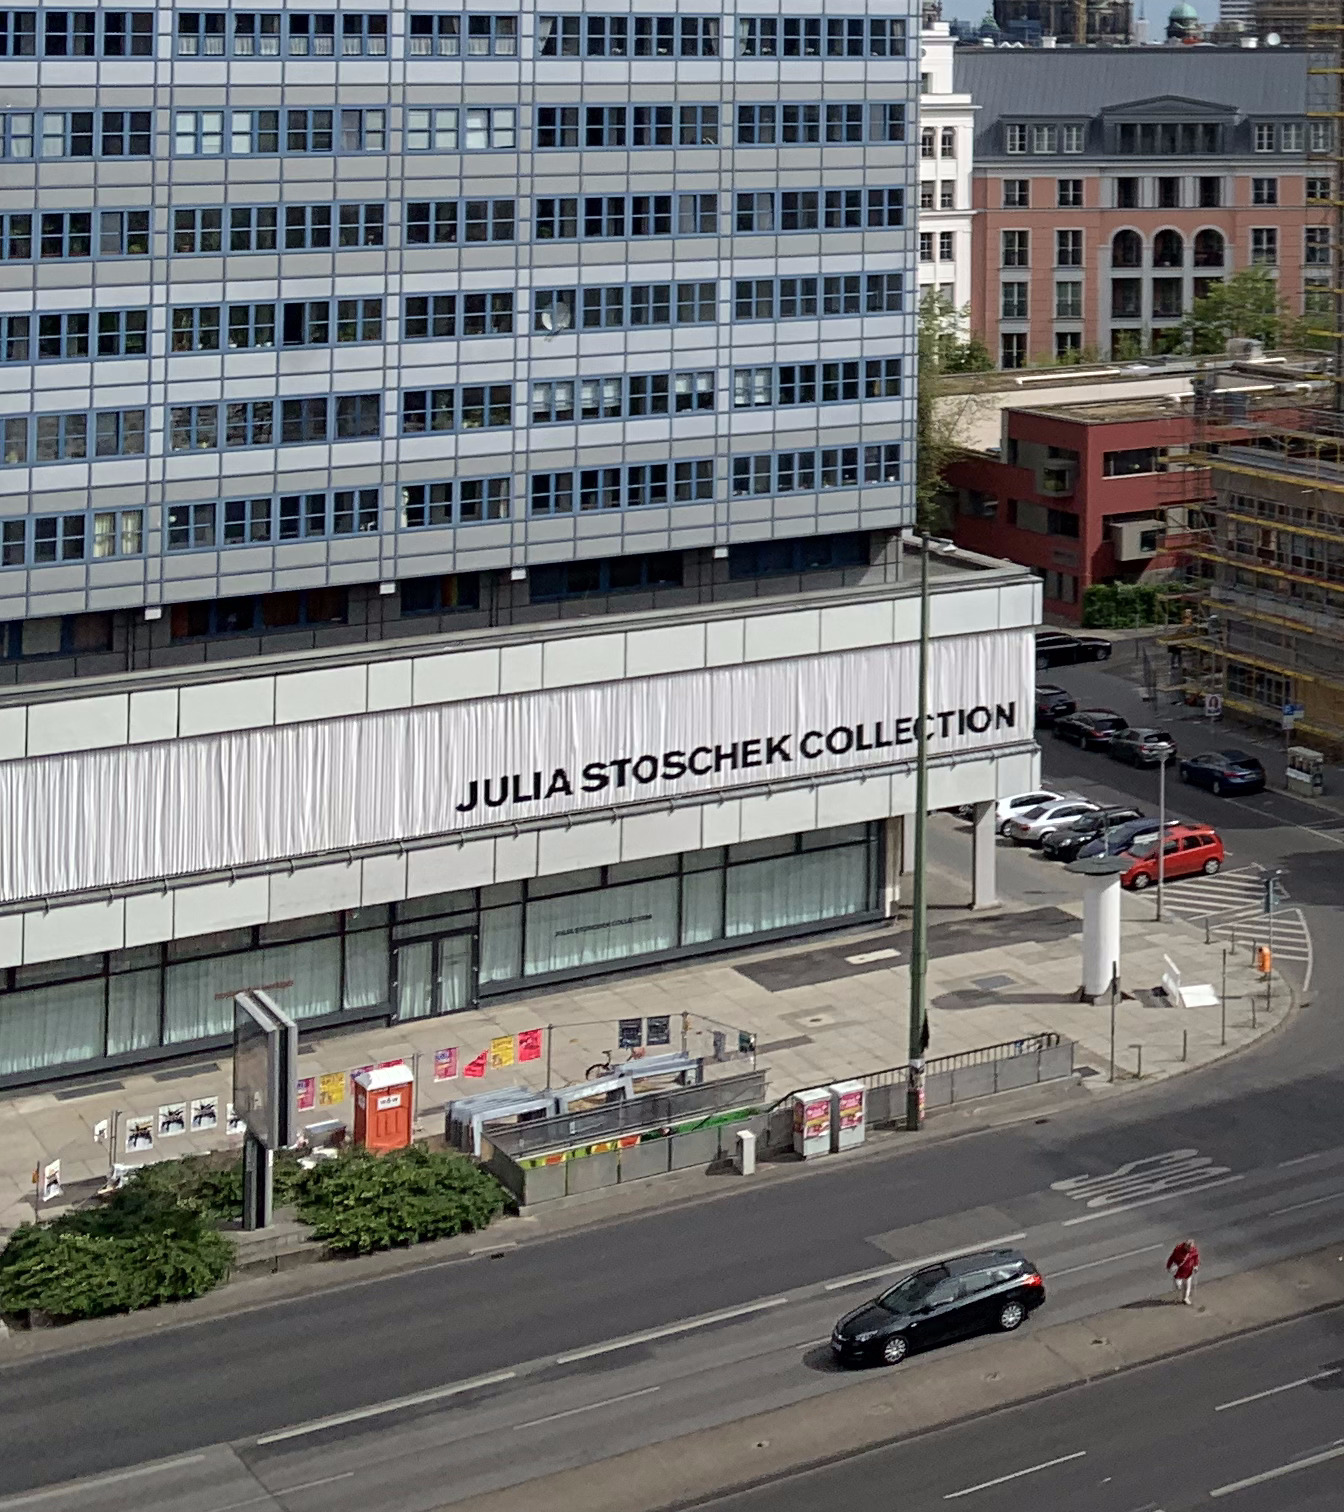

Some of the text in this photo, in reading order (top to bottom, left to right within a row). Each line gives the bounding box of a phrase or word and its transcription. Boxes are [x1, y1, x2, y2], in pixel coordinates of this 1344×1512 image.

[455, 701, 1016, 813] JULIA STOSCHEK COLLECTION
